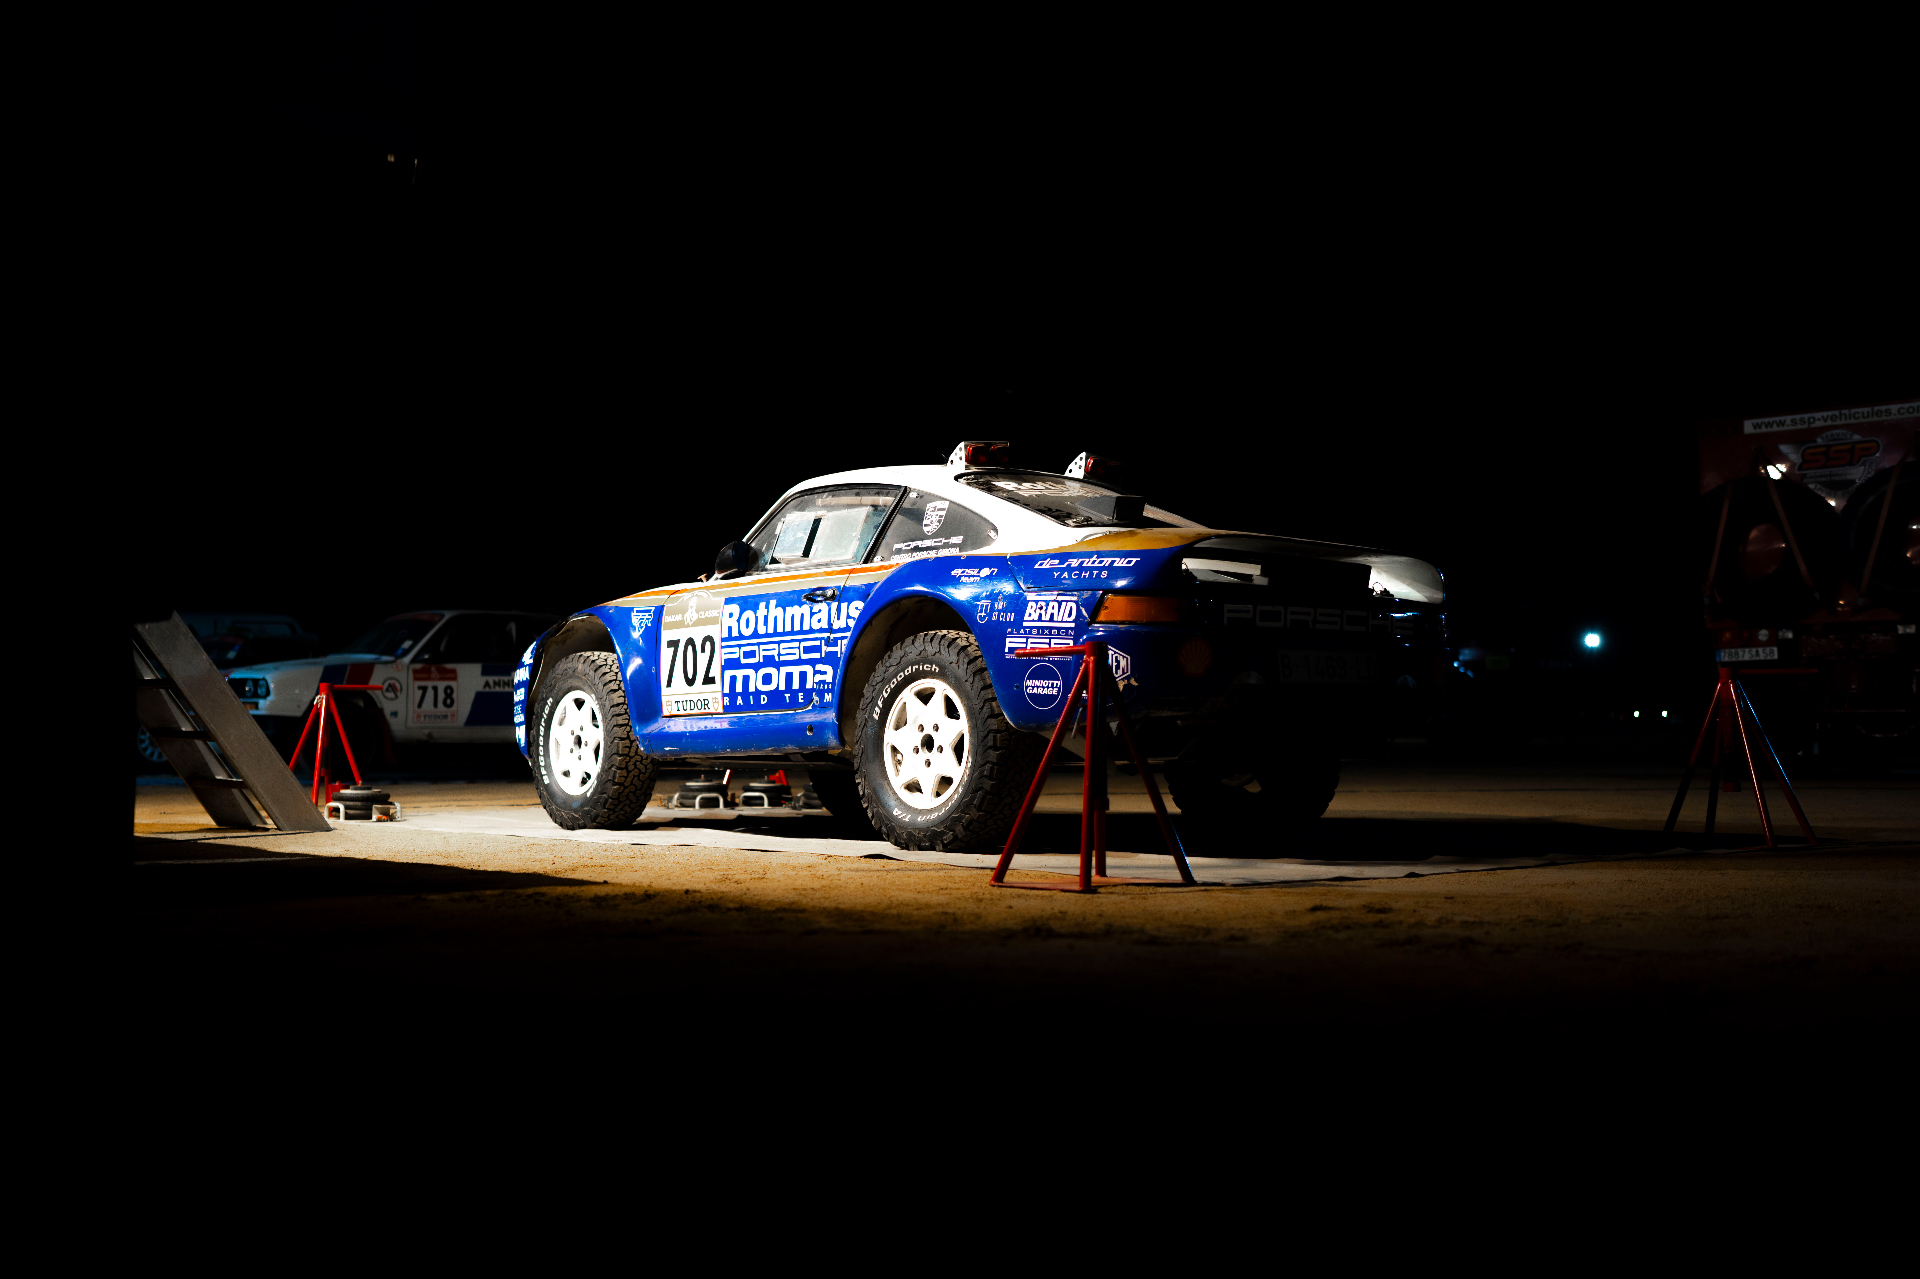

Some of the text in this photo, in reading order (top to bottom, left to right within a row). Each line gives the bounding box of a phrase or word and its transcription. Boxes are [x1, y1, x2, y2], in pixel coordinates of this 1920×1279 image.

[1801, 442, 1879, 470] SSP
[893, 535, 964, 552] PORSCHE
[1053, 570, 1108, 579] YACHTS
[664, 610, 720, 622] DAKAR CLASSIC
[1023, 601, 1078, 622] BRAID
[1223, 603, 1415, 636] PORSCHE
[666, 635, 717, 688] 702
[873, 662, 940, 720] BFGoodrich
[1026, 679, 1060, 688] MINIOTTI
[1026, 687, 1058, 695] GARAGE
[417, 685, 455, 709] 718
[674, 698, 710, 712] TUDOR
[724, 695, 768, 706] RAID
